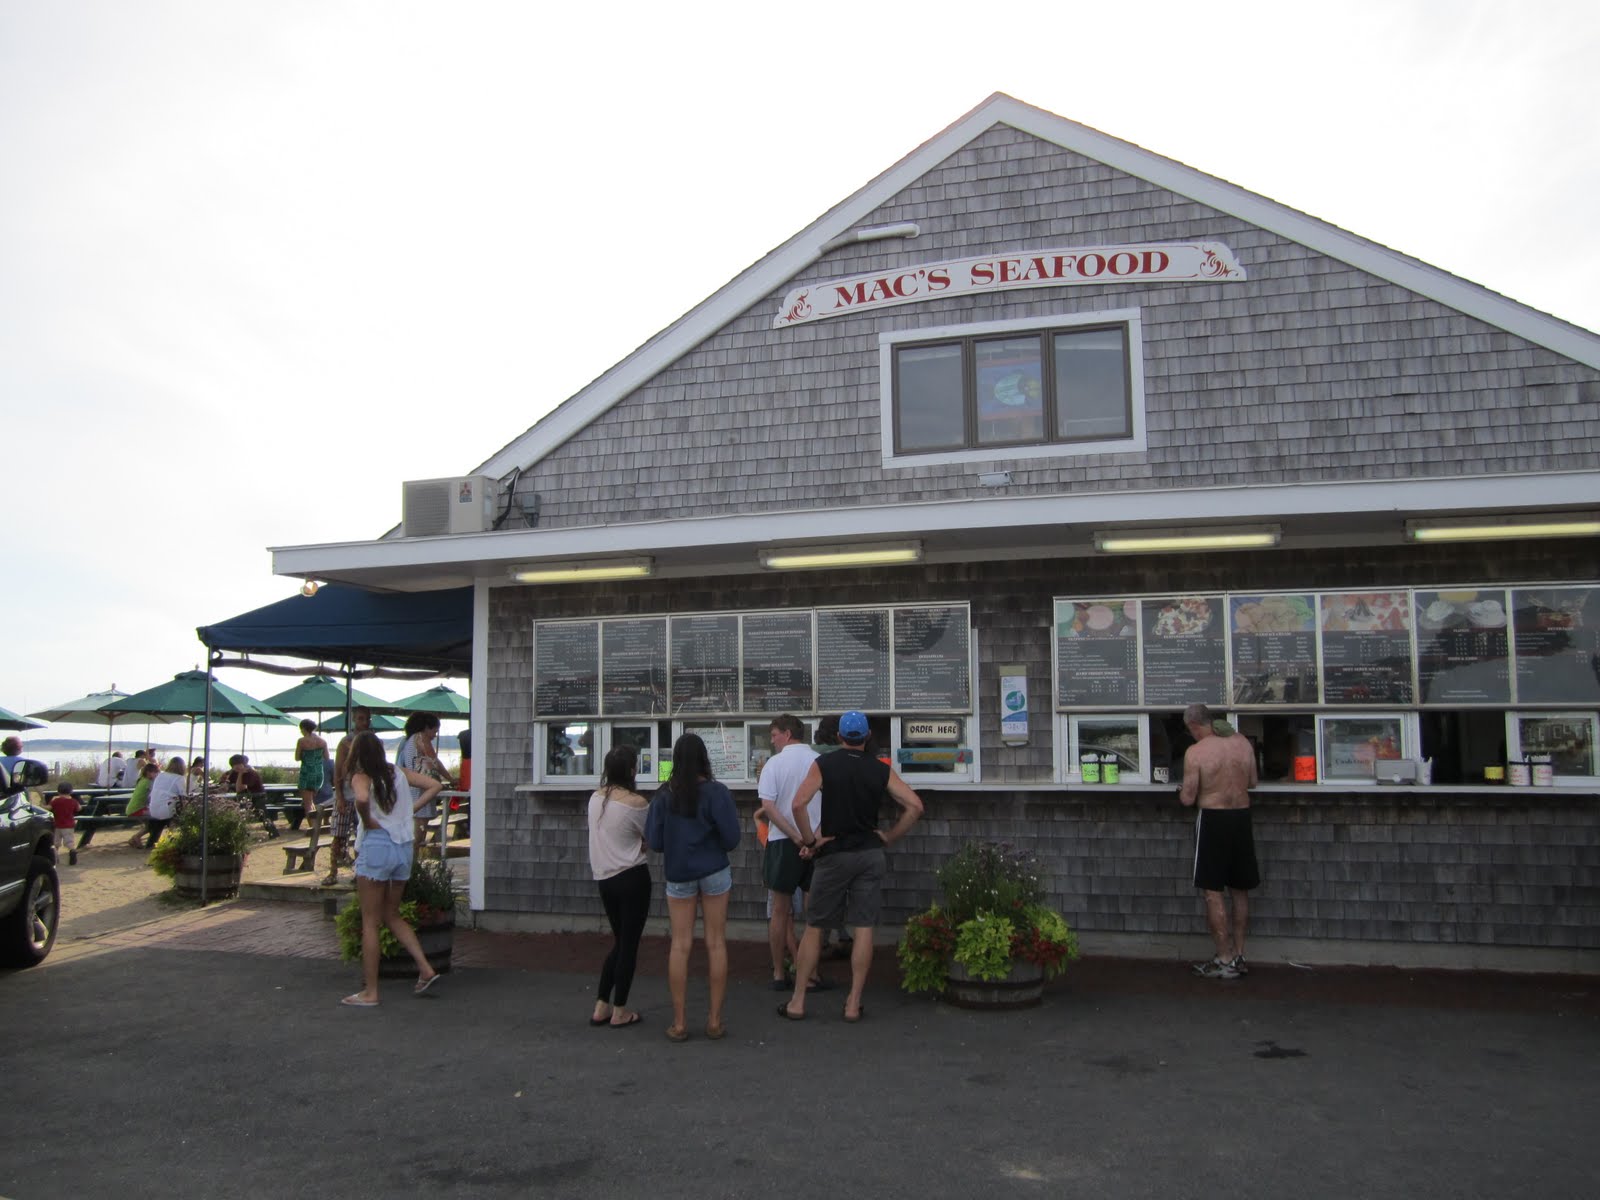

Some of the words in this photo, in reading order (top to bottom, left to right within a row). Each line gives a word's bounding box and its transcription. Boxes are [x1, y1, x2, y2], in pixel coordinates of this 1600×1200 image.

[833, 267, 951, 308] MAC'S
[970, 251, 1169, 286] SEAFOOD
[910, 725, 933, 734] ORDER
[937, 725, 957, 734] HERE
